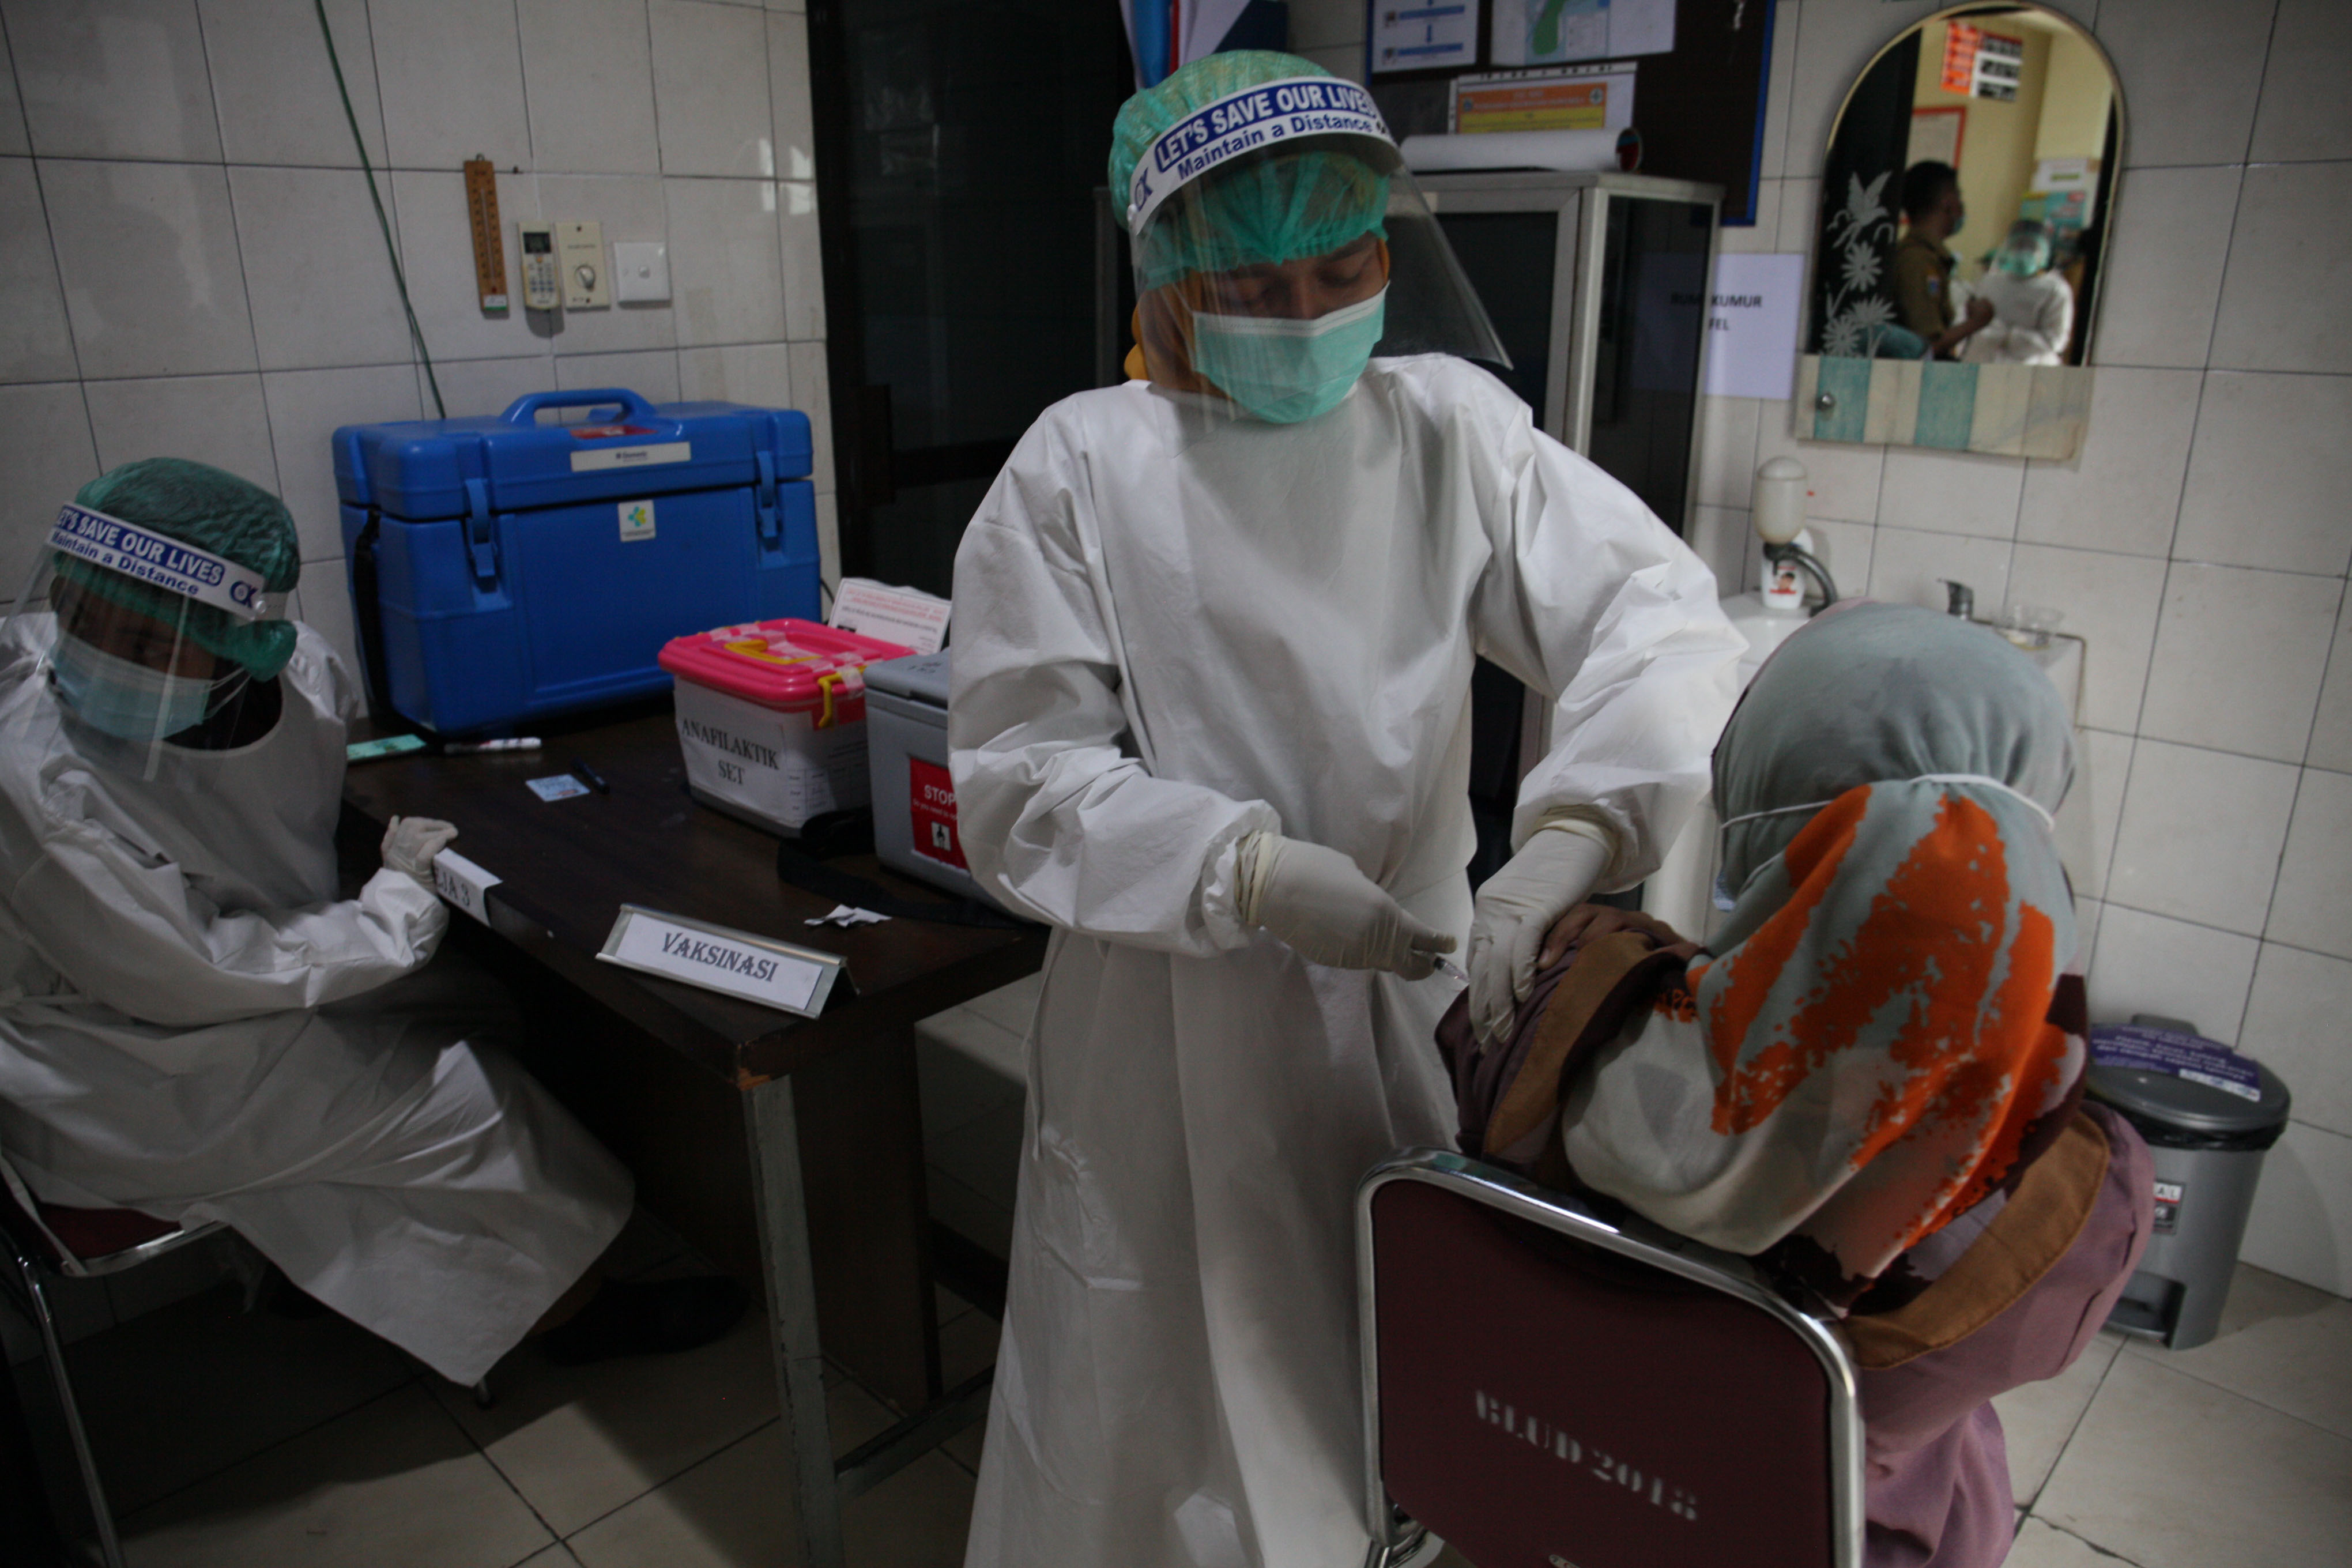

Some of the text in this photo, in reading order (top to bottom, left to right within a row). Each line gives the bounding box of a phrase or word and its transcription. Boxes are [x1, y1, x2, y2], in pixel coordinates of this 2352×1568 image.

[1157, 117, 1209, 169] LET'S
[1211, 92, 1274, 135] SAVE
[1276, 85, 1326, 114] OUR
[1178, 114, 1373, 180] Maintain a Distance
[1708, 318, 1729, 330] FEL
[1711, 295, 1762, 307] KUMUR
[56, 508, 224, 586] ET'S SAVE OUR LIVES
[103, 553, 114, 564] a
[118, 556, 199, 595] Distance
[681, 718, 779, 770] ANAFILAKTIK
[718, 760, 747, 785] SET
[924, 784, 956, 806] STOP
[661, 932, 779, 982] VAKSINASI
